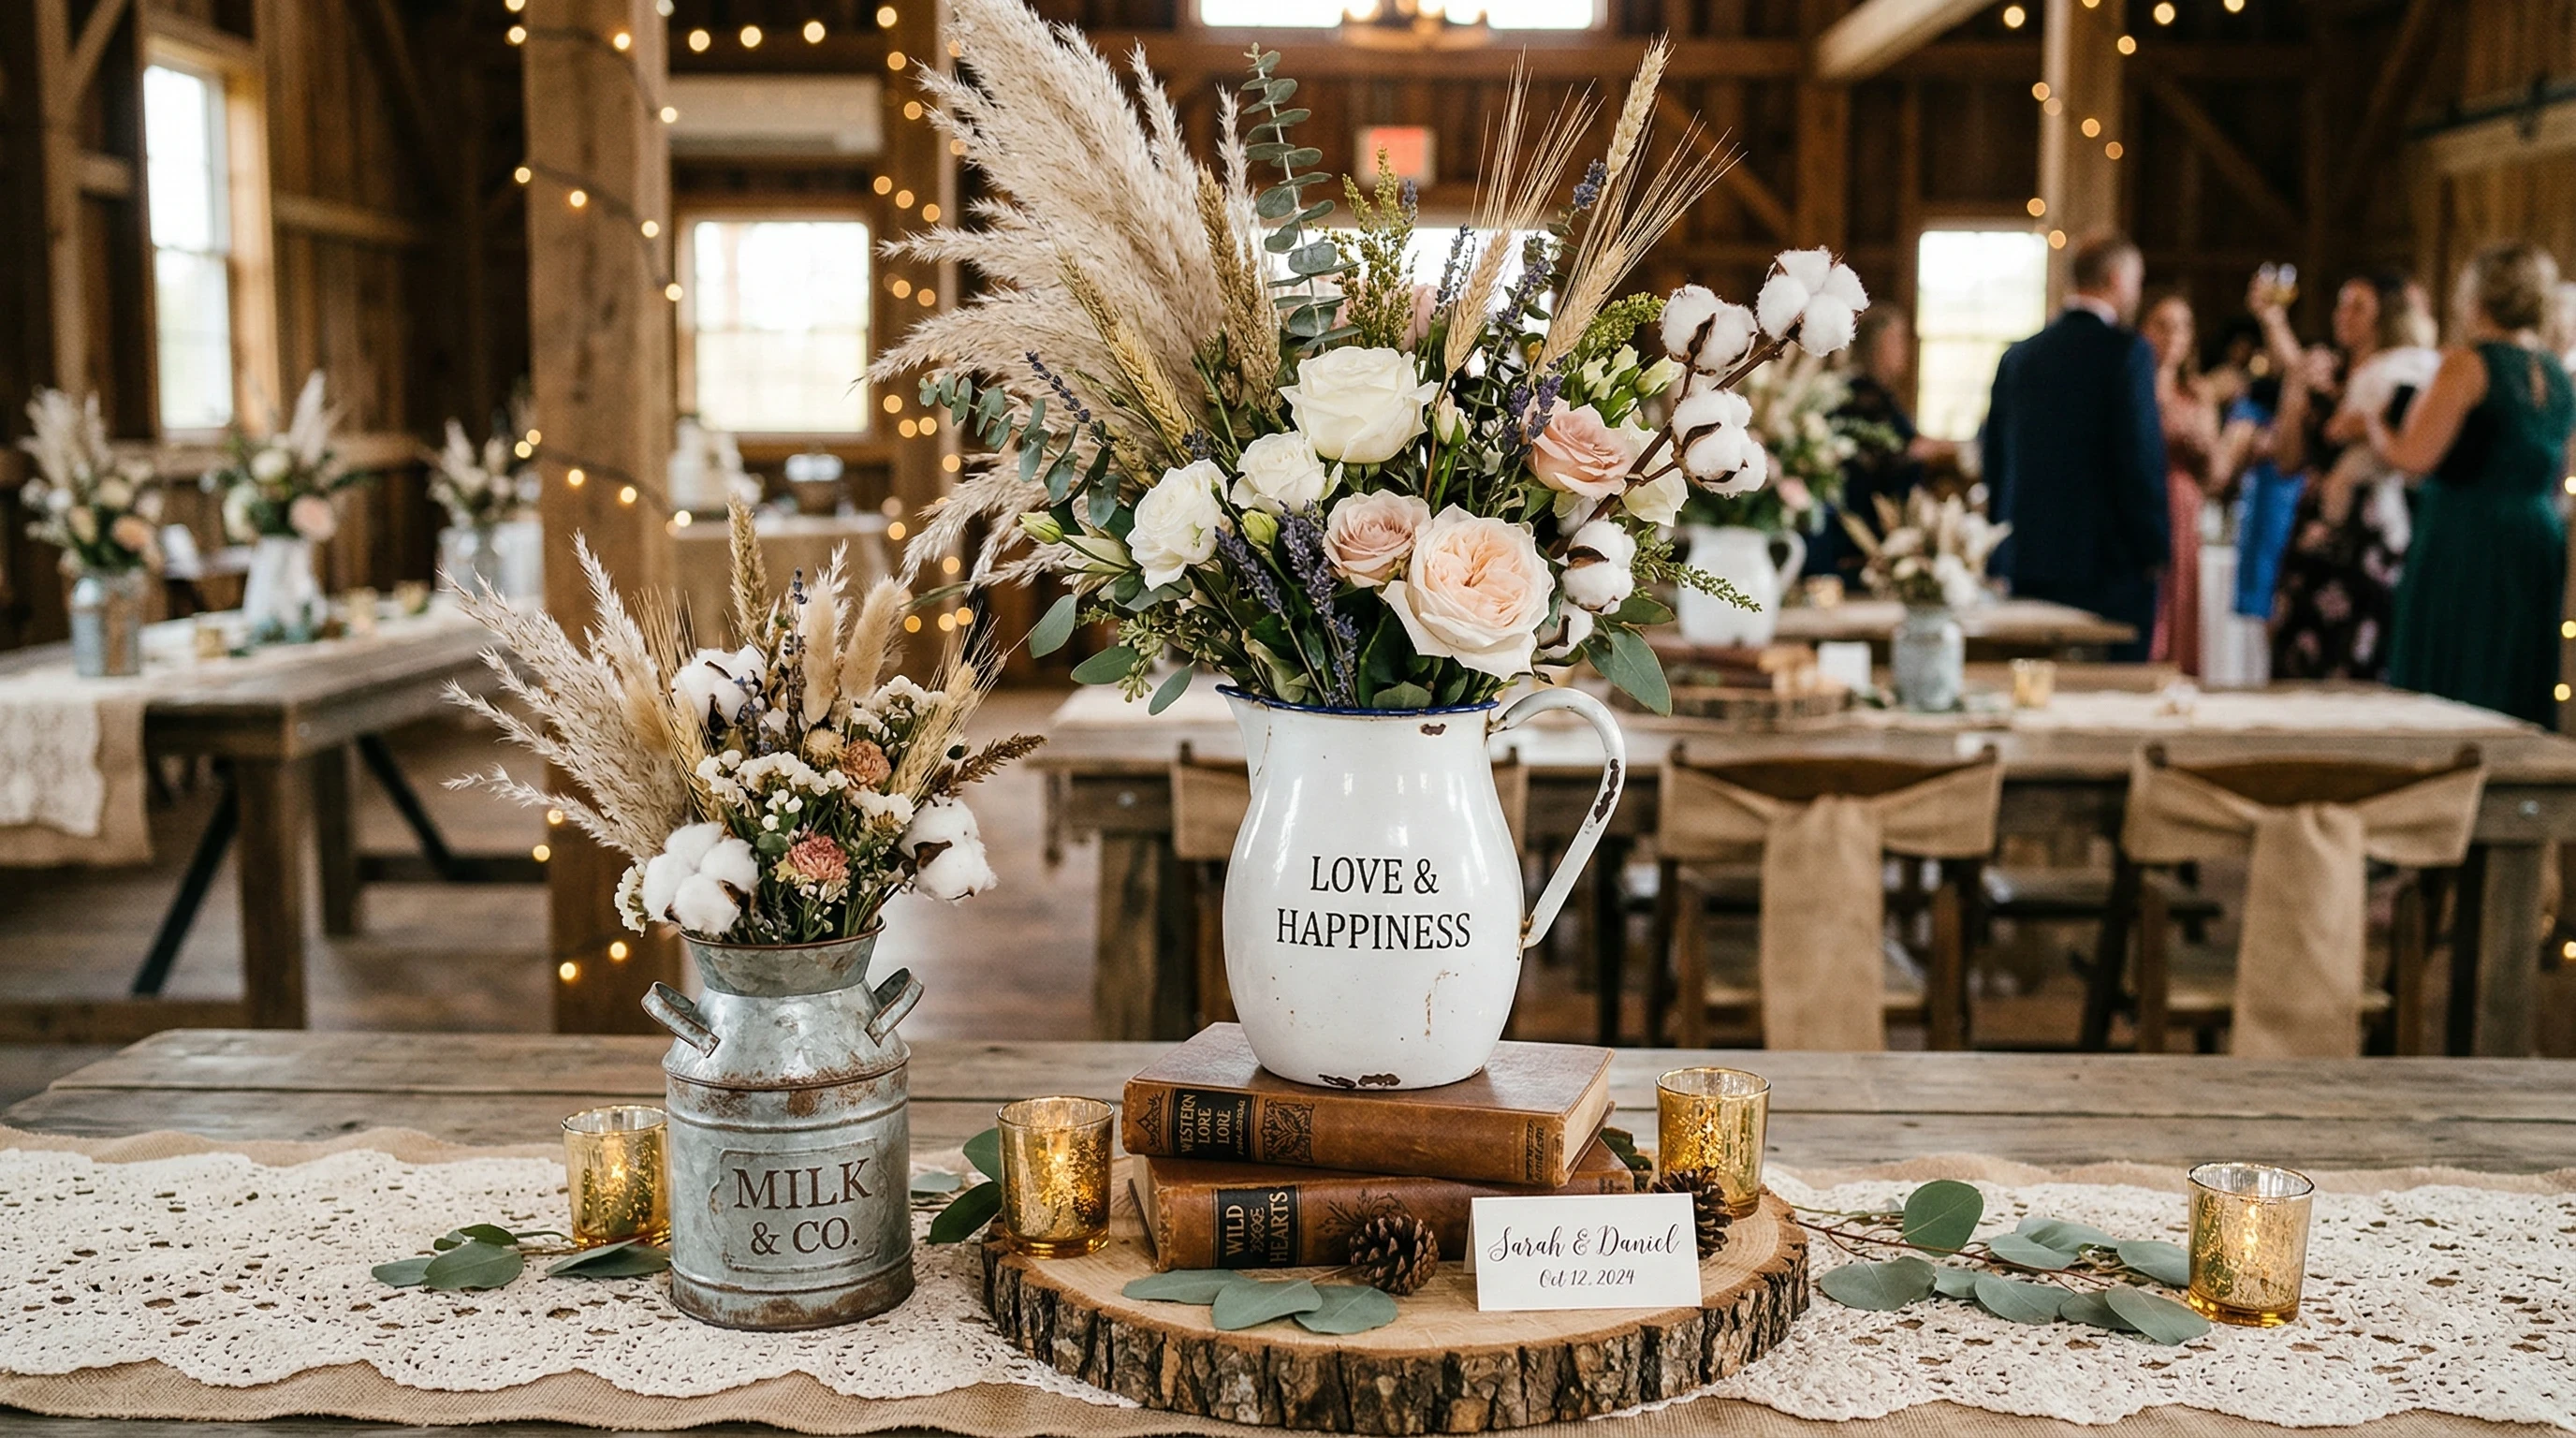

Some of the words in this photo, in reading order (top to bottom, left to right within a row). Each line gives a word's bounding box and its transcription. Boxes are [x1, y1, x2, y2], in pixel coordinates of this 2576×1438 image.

[1310, 856, 1403, 894] LOVE
[1413, 858, 1440, 895] &
[1276, 908, 1471, 950] HAPPINESS
[1179, 1093, 1196, 1153] WESTERN
[1198, 1108, 1212, 1144] LORE
[1217, 1109, 1231, 1145] LORE
[732, 1157, 872, 1210] MILK
[750, 1221, 781, 1255] &
[792, 1216, 858, 1254] CO.
[1225, 1204, 1244, 1257] WILD
[1268, 1191, 1289, 1263] HEARTS
[1487, 1225, 1565, 1262] Sarah
[1573, 1227, 1591, 1256] &
[1596, 1223, 1680, 1257] Daniel
[1539, 1269, 1567, 1288] Oct
[1597, 1269, 1636, 1285] 2024
